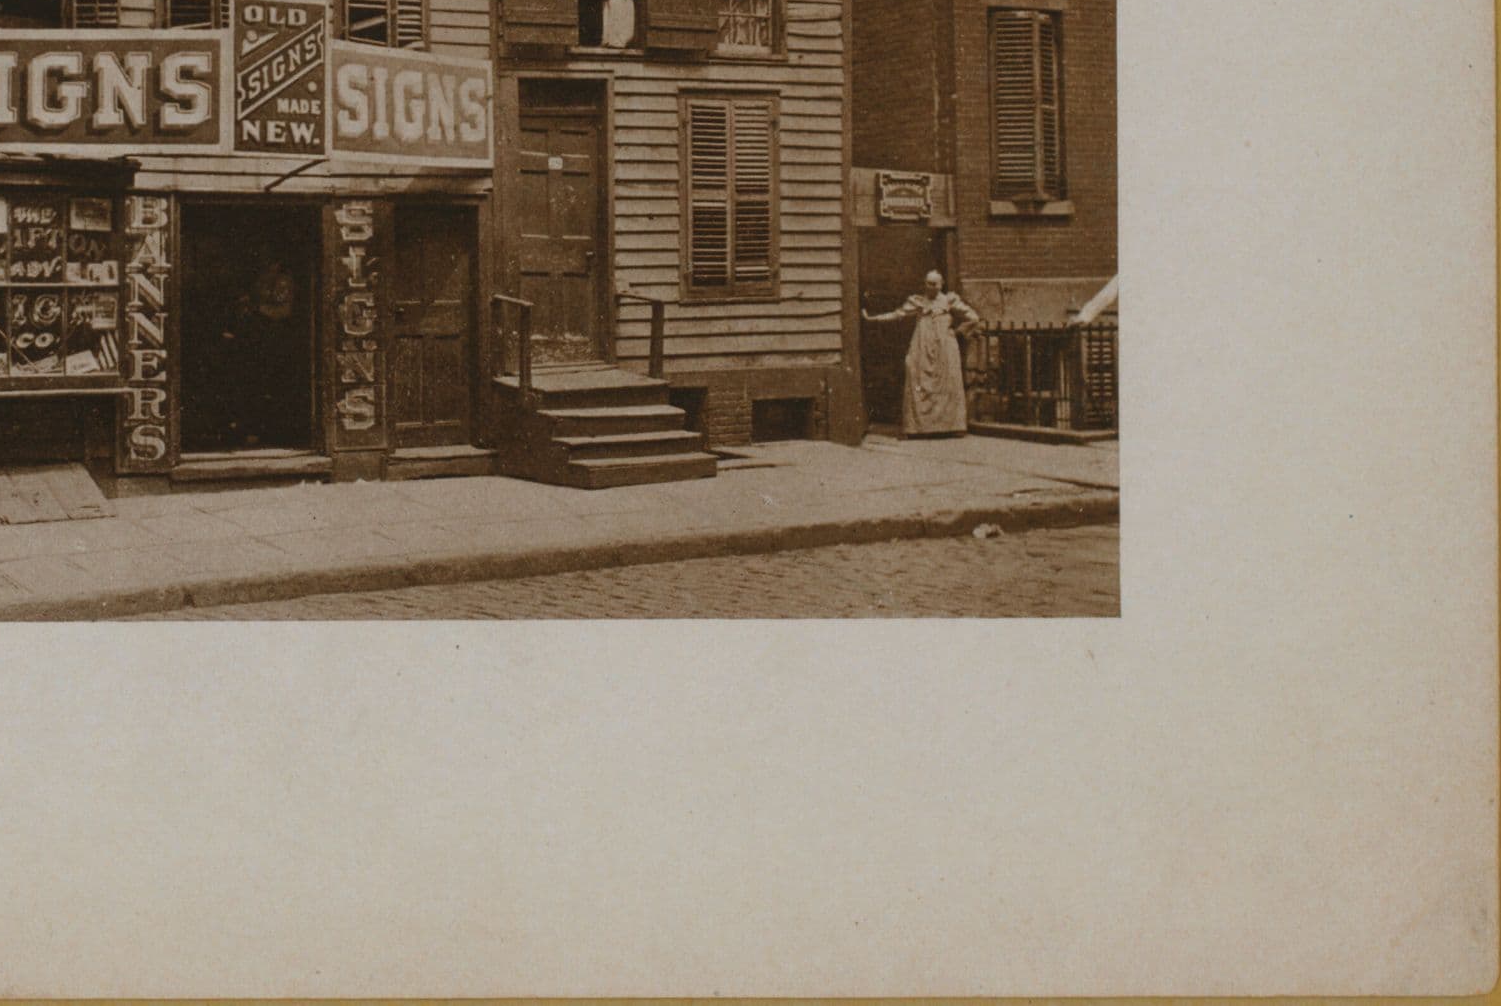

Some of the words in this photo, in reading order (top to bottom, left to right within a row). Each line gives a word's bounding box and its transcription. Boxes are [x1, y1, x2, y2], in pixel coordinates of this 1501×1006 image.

[243, 5, 307, 26] OLD
[247, 34, 318, 99] SIGNS
[277, 98, 321, 115] MADE
[336, 60, 488, 143] SIGNS
[242, 120, 320, 145] NEW.
[14, 206, 57, 224] THE
[127, 196, 170, 462] BANNERS
[334, 200, 376, 431] SIGNS
